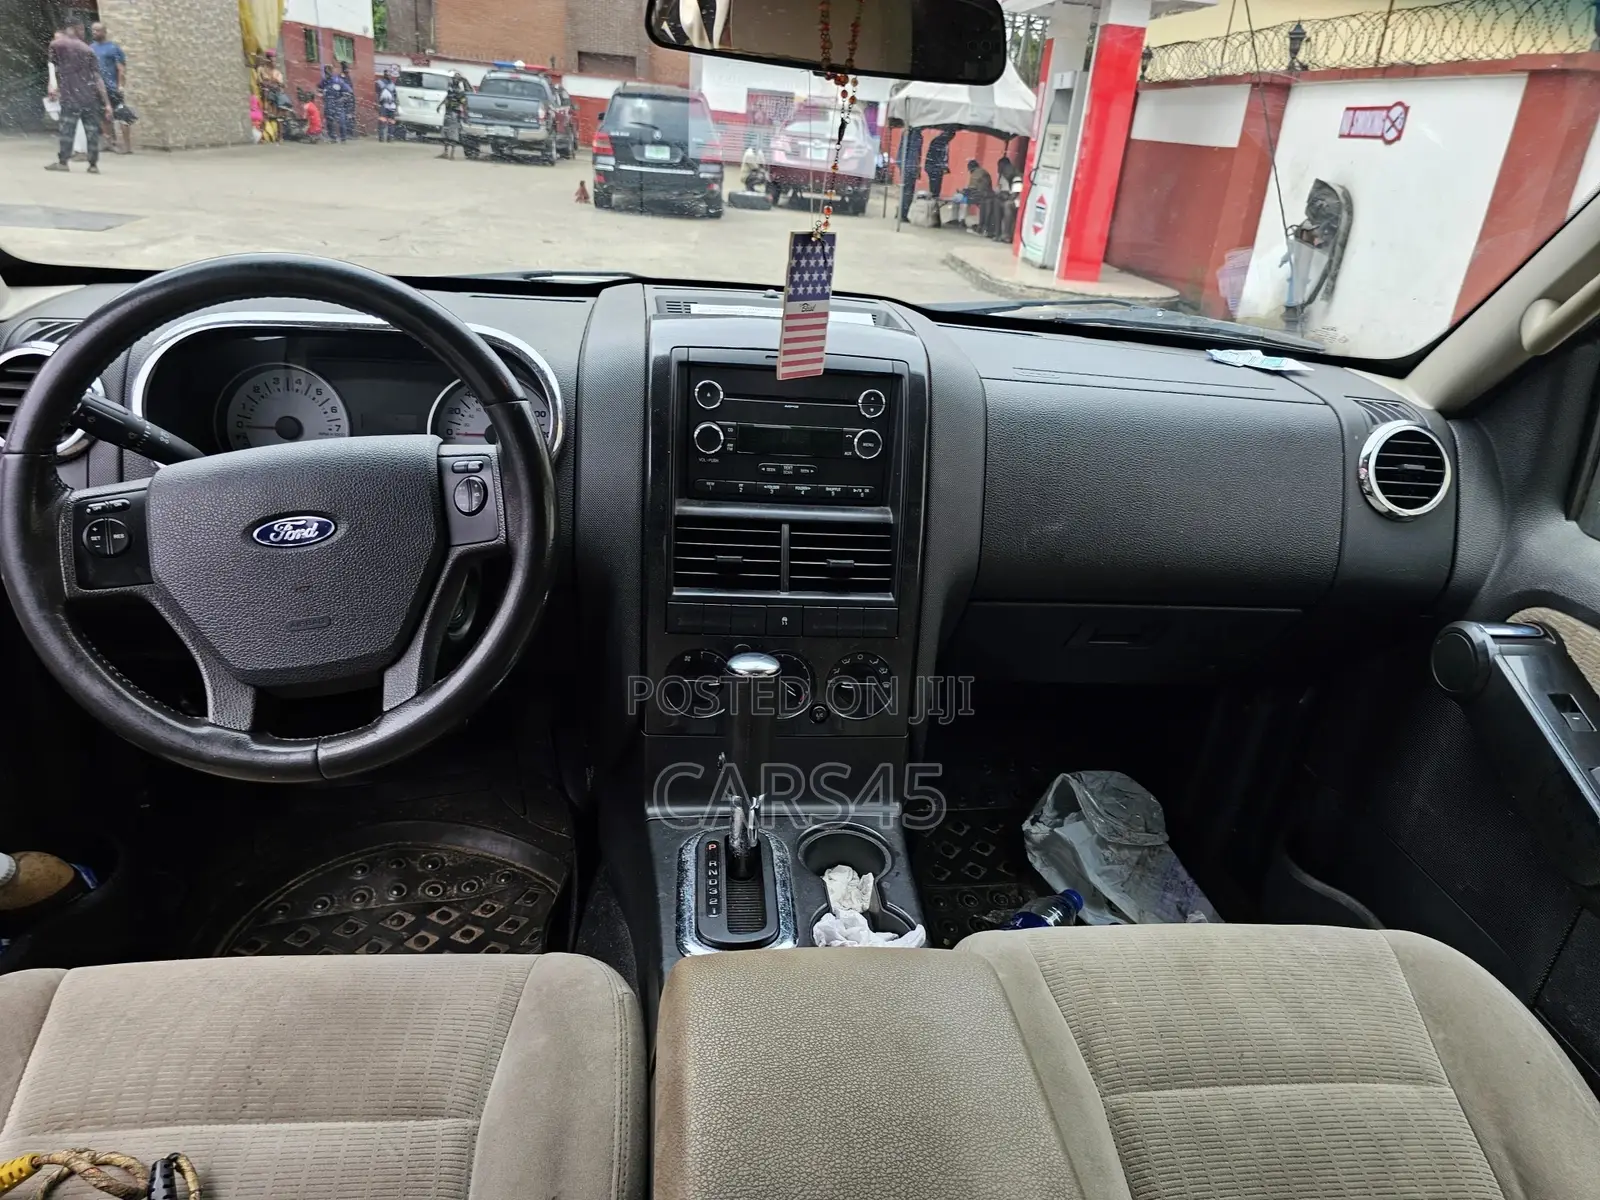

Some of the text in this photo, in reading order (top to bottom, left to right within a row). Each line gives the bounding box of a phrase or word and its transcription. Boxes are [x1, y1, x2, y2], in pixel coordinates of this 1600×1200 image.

[273, 377, 280, 385] 3
[316, 388, 323, 396] 5
[335, 424, 341, 432] 7
[269, 519, 318, 540] Ford
[708, 843, 717, 851] P
